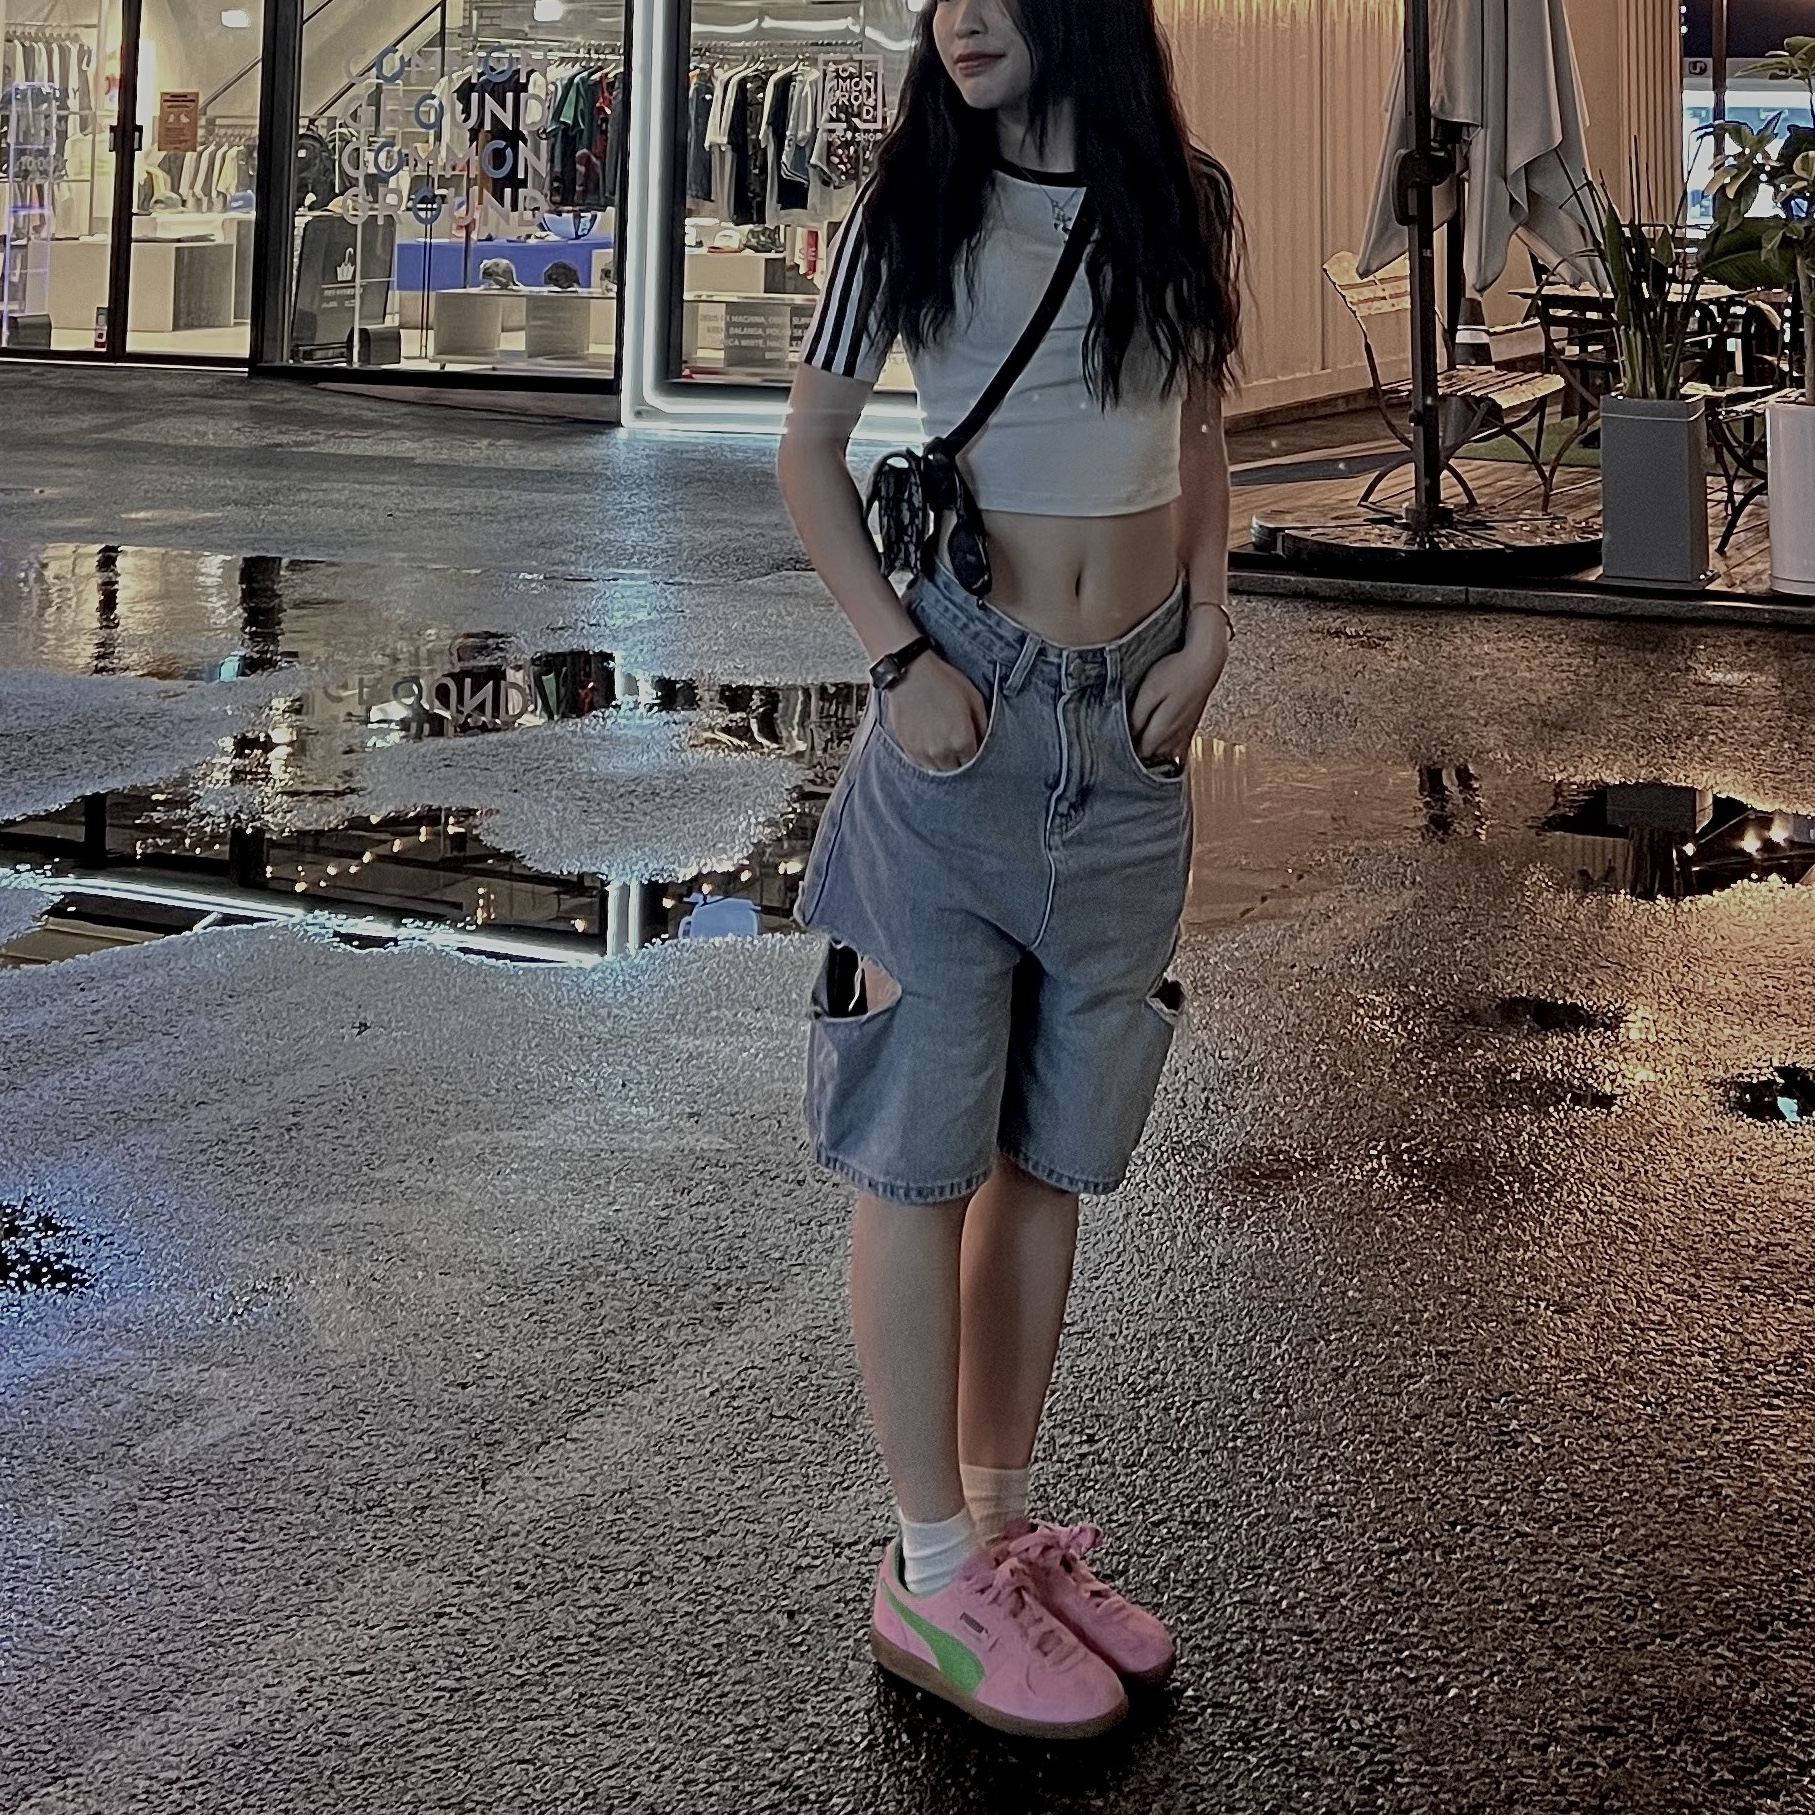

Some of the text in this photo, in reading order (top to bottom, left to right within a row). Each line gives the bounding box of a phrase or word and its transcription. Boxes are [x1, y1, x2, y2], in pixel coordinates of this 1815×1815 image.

[343, 46, 550, 84] COMMON
[343, 92, 548, 131] GROUND
[341, 139, 548, 179] COMMON
[341, 186, 549, 227] GROUND
